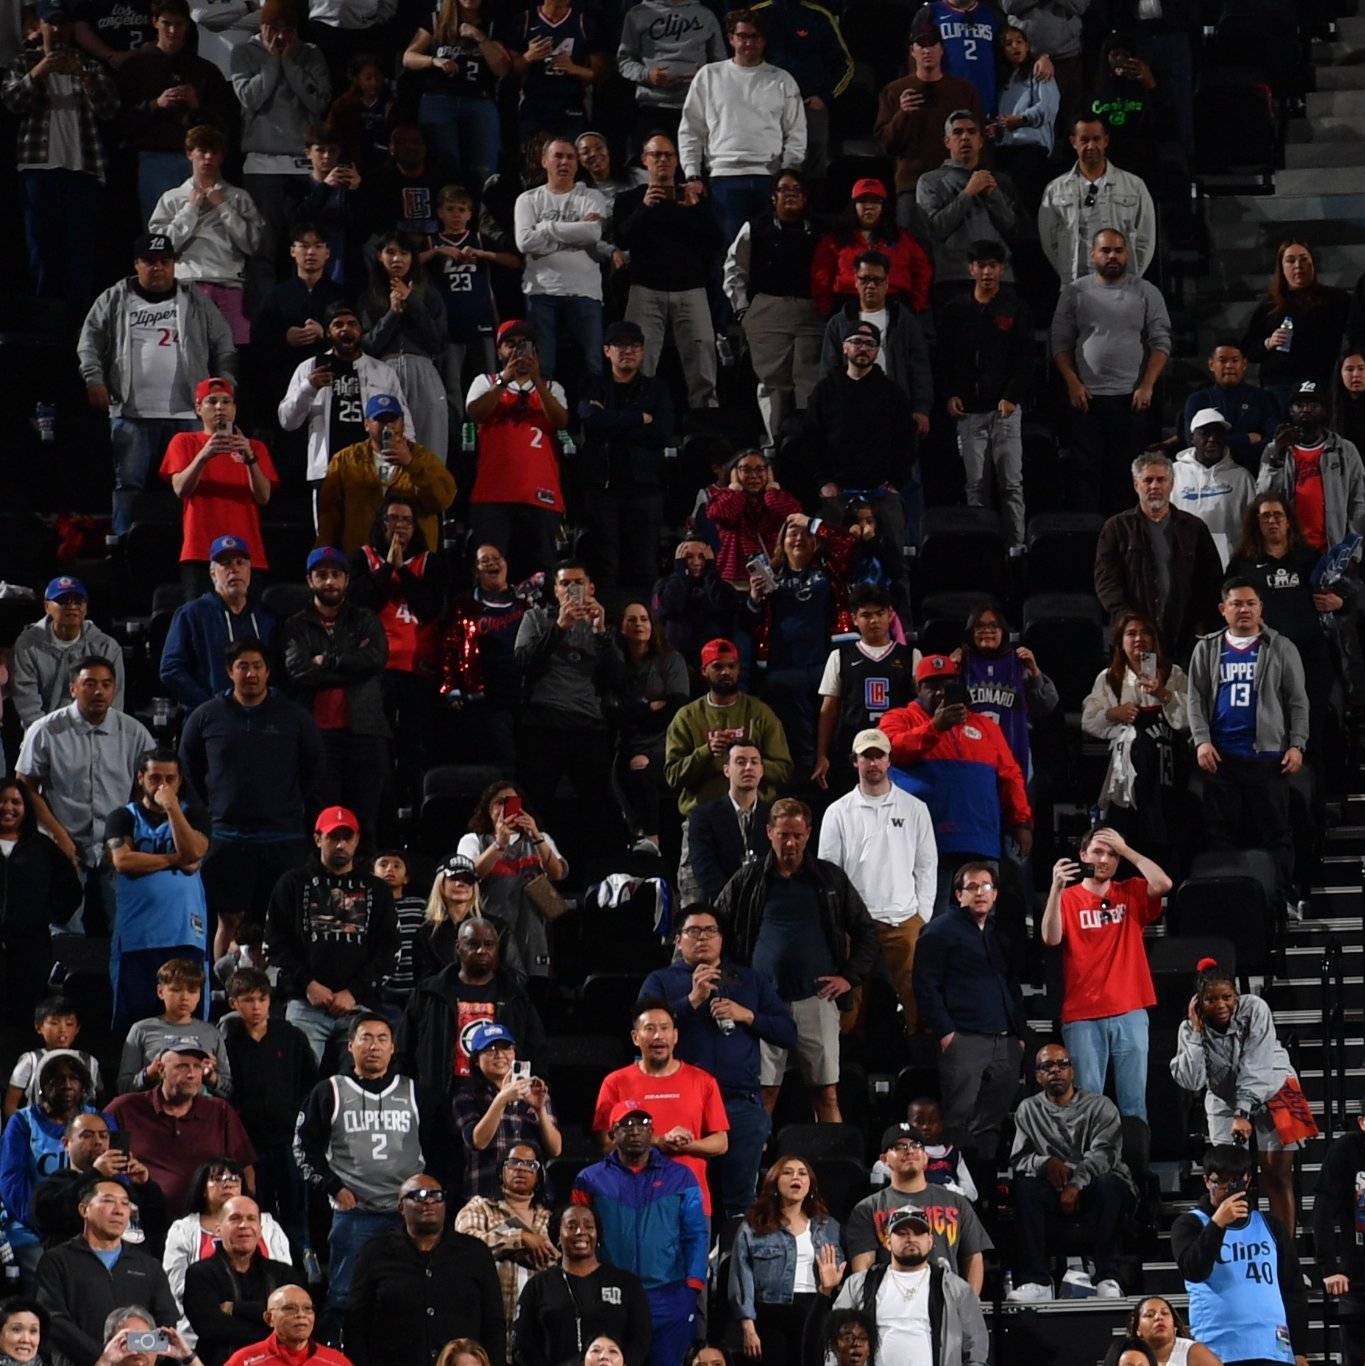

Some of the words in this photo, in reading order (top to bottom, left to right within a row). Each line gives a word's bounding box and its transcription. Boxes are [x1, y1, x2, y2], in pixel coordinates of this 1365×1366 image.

[649, 13, 704, 41] Clips
[940, 21, 993, 41] CLIPPERS
[130, 32, 144, 49] 2
[965, 40, 977, 60] 2
[465, 61, 479, 81] 2
[449, 273, 472, 292] 23
[129, 311, 177, 328] Clipper
[340, 400, 362, 423] 25
[529, 426, 542, 449] 2
[1220, 662, 1256, 684] LIPPE
[969, 687, 1014, 709] EONARD
[1229, 683, 1250, 707] 13
[891, 817, 905, 828] W
[892, 818, 904, 827] W
[343, 1109, 412, 1134] CLIPPERS
[371, 1133, 389, 1162] 2
[1215, 1236, 1272, 1266] Clips
[1245, 1260, 1274, 1286] 40
